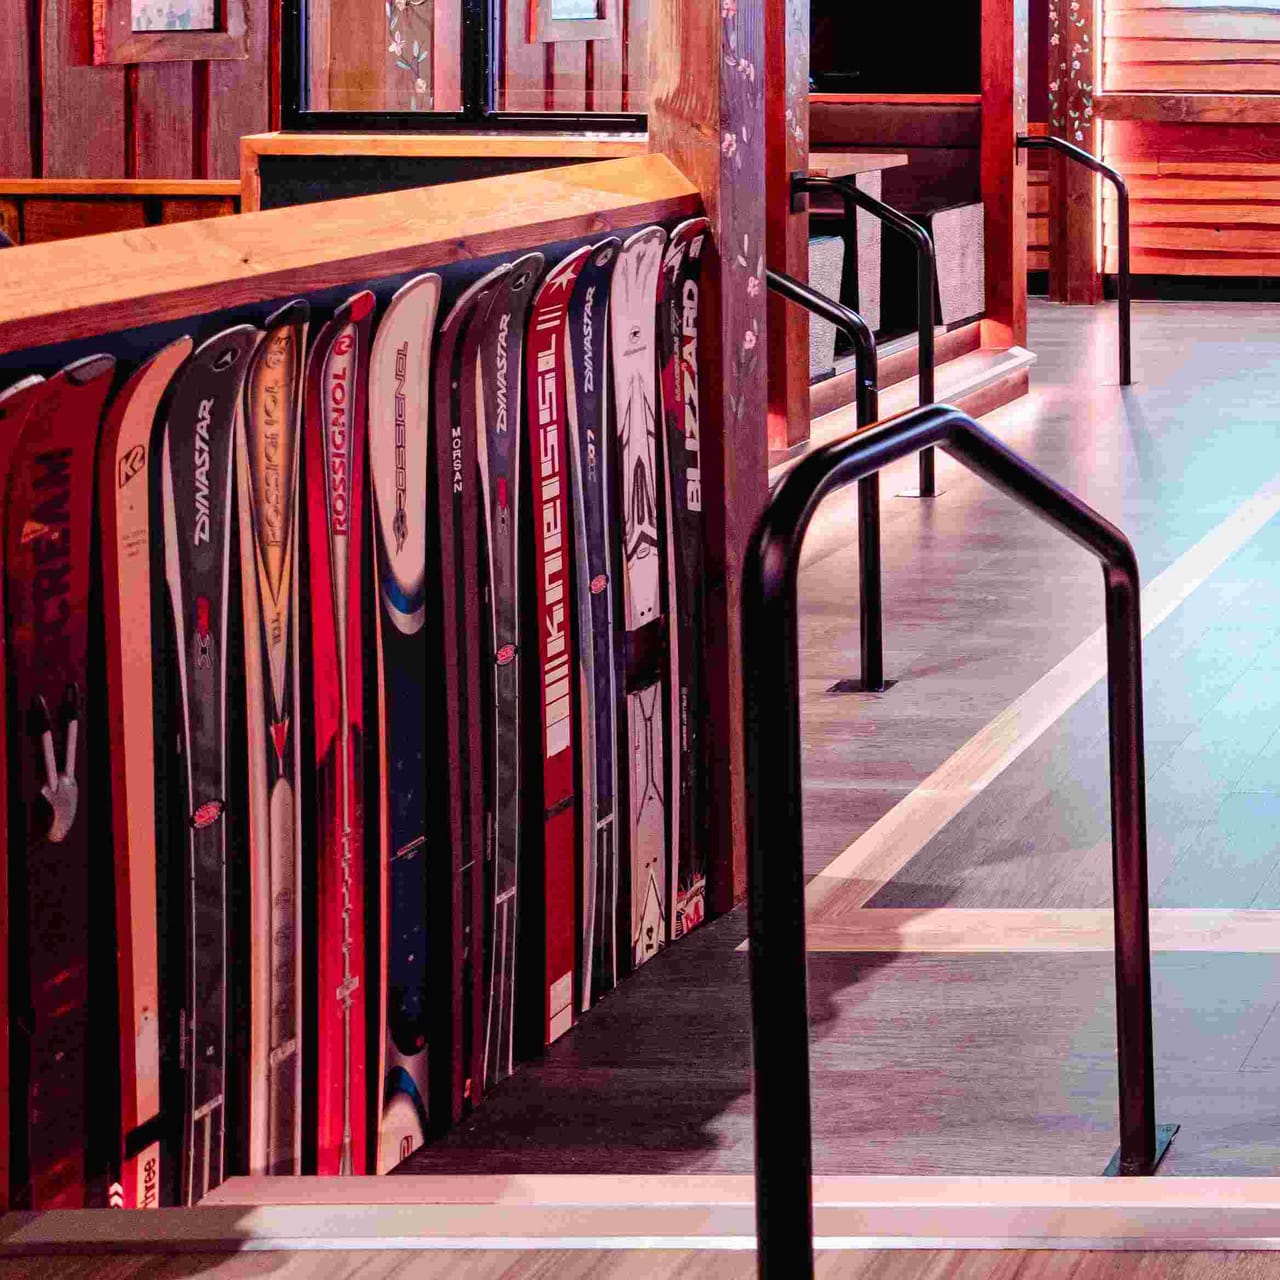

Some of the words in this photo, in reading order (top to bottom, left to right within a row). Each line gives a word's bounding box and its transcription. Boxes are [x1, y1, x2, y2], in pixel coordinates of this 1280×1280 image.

[496, 312, 511, 433] DYNASTAR
[583, 285, 596, 394] DYNASTAR
[681, 279, 702, 512] BLIZZARD
[193, 397, 214, 547] DYNASTAR
[332, 366, 349, 537] ROSSIGNOL
[394, 341, 409, 513] ROSSIGNOL
[450, 425, 463, 494] MORSAN
